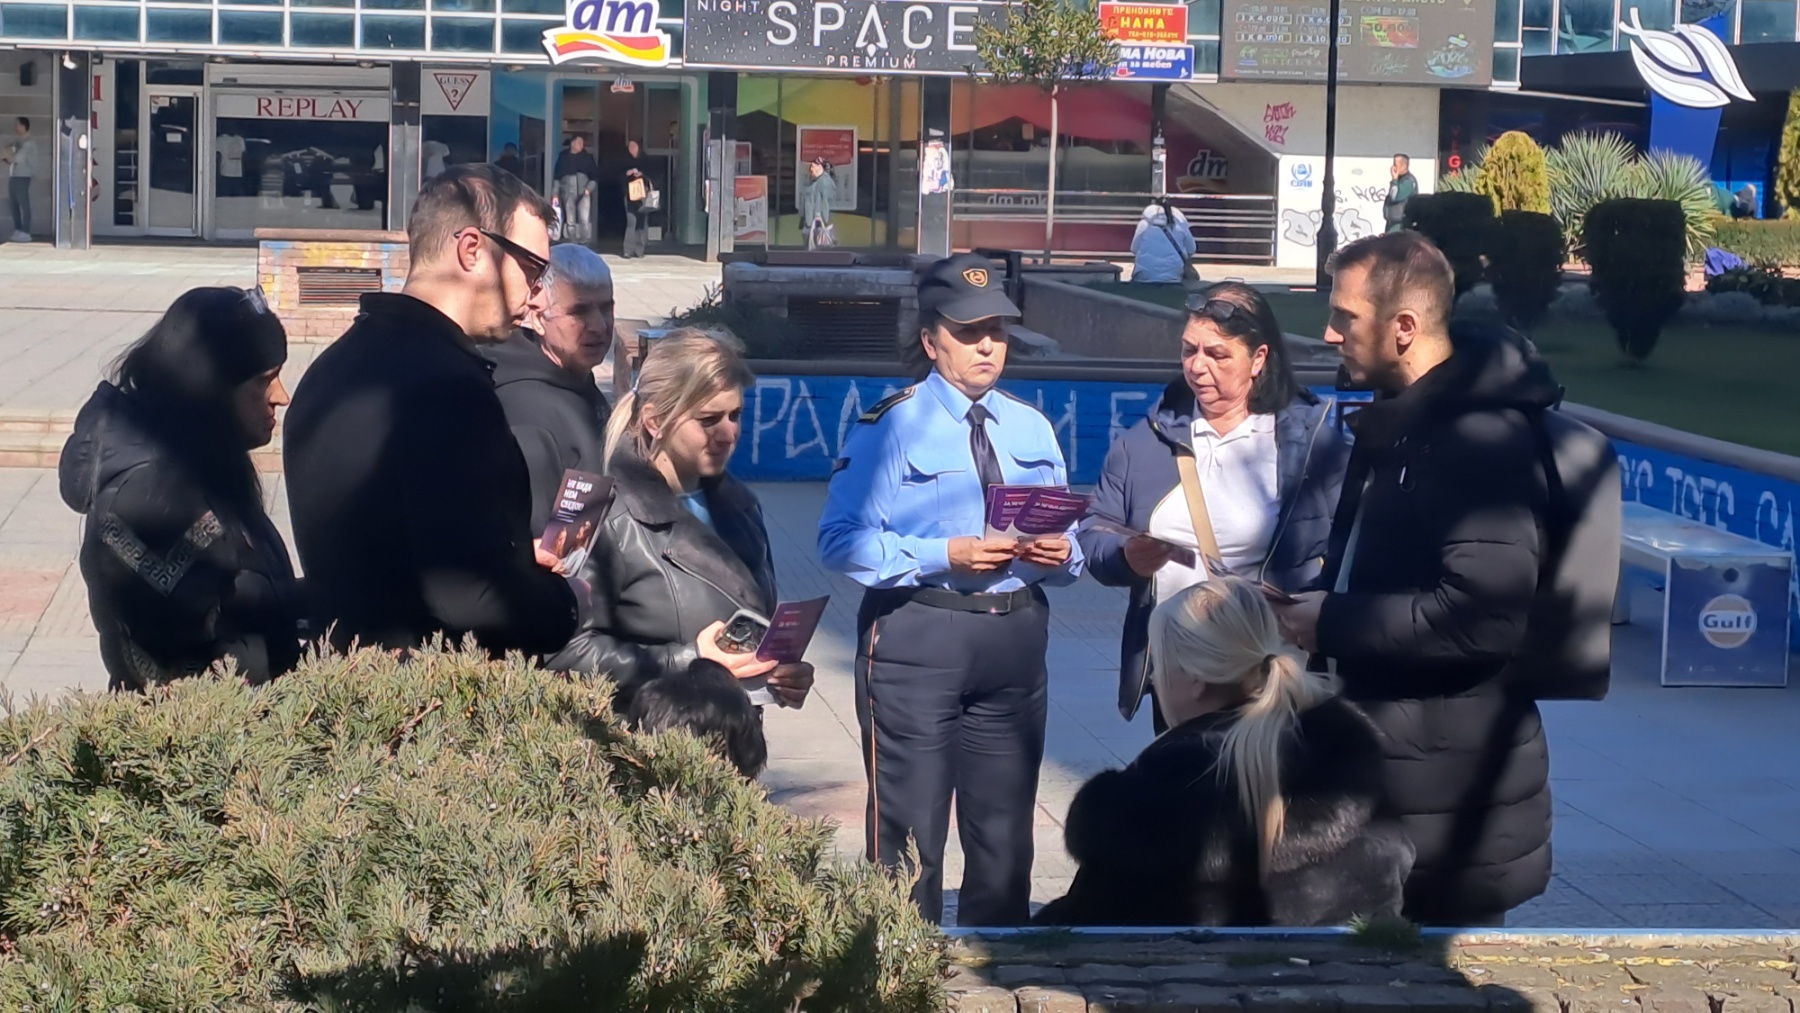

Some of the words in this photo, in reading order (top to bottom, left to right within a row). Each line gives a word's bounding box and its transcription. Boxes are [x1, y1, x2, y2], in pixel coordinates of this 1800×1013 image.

[697, 0, 760, 13] NIGHT
[572, 0, 654, 33] dm
[766, 1, 979, 51] SPACE
[1143, 47, 1186, 60] НОВА
[826, 55, 916, 69] PREMIUM
[440, 76, 470, 85] GUESS
[256, 97, 364, 118] REPLAY
[1190, 150, 1228, 177] dm
[1703, 613, 1753, 629] Gulf
